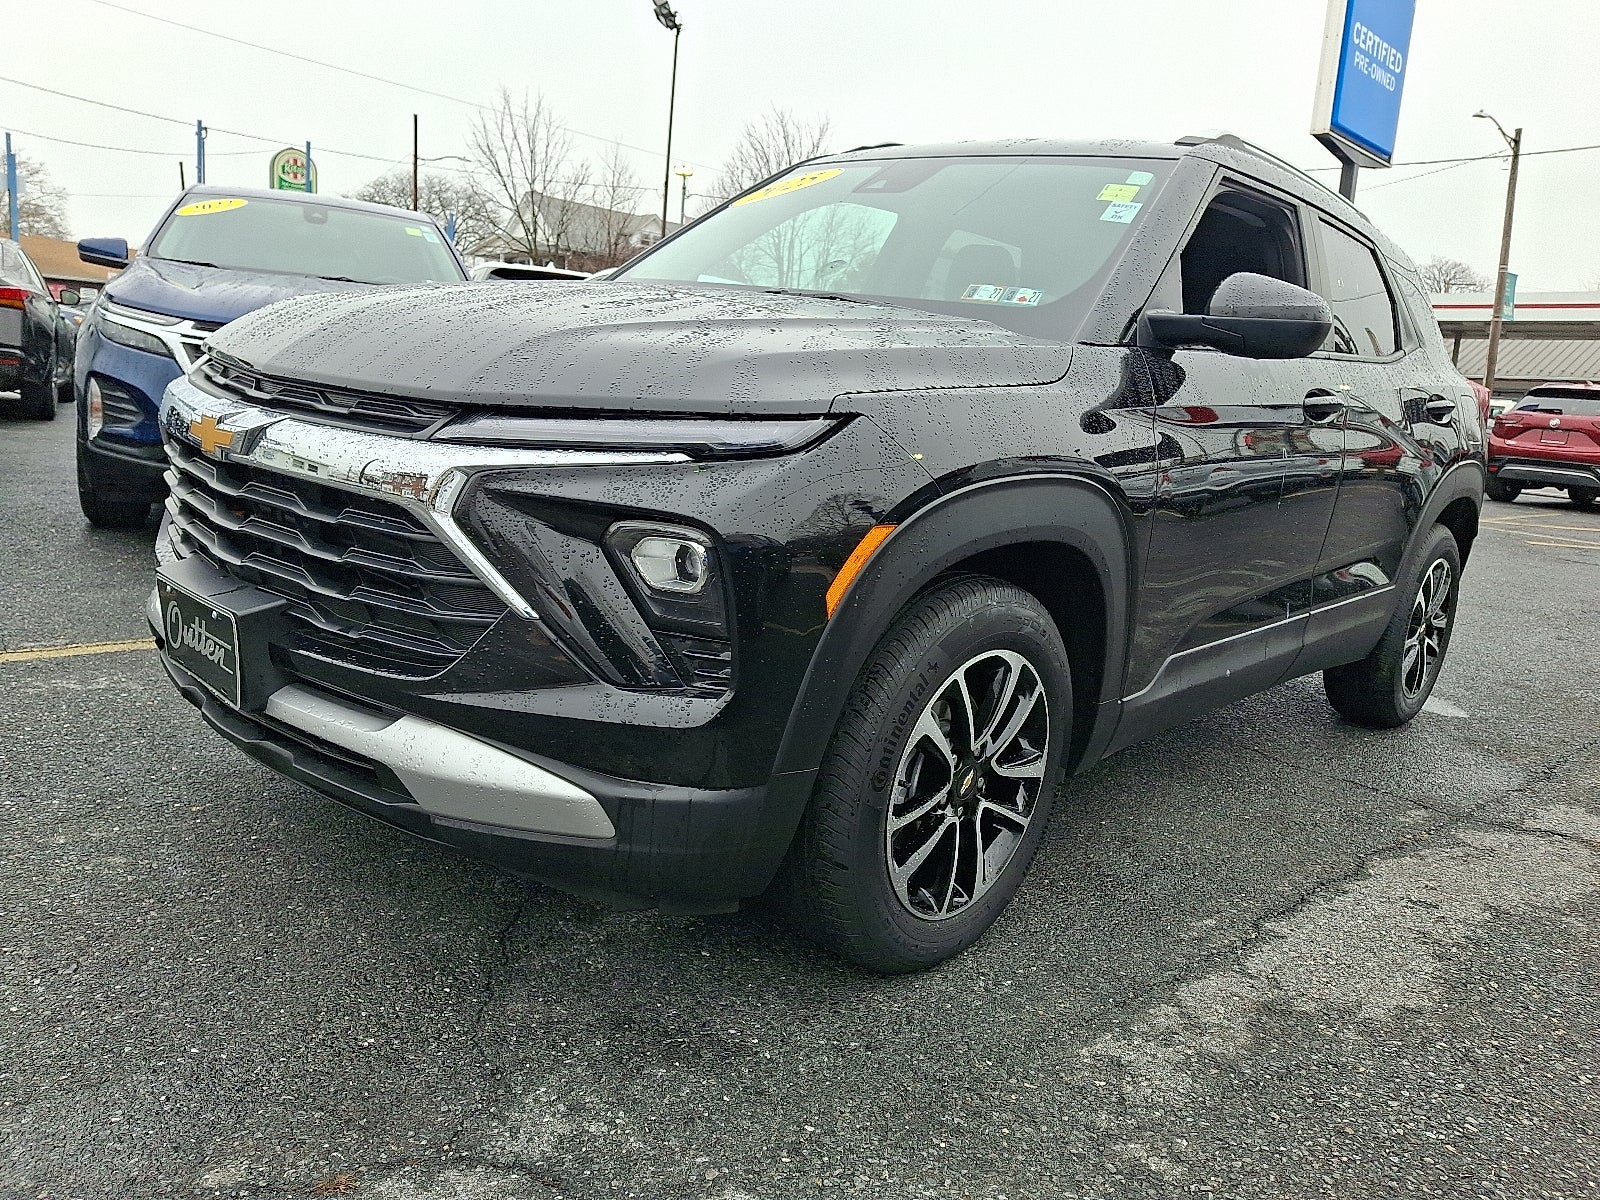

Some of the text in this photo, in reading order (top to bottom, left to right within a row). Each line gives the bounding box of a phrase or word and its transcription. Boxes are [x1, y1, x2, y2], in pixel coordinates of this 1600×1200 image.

[1353, 21, 1403, 74] CERTIFIED
[1354, 49, 1396, 91] PRE-OWNED
[1027, 291, 1042, 303] 27
[166, 600, 233, 675] Outten
[871, 671, 930, 793] Continental
